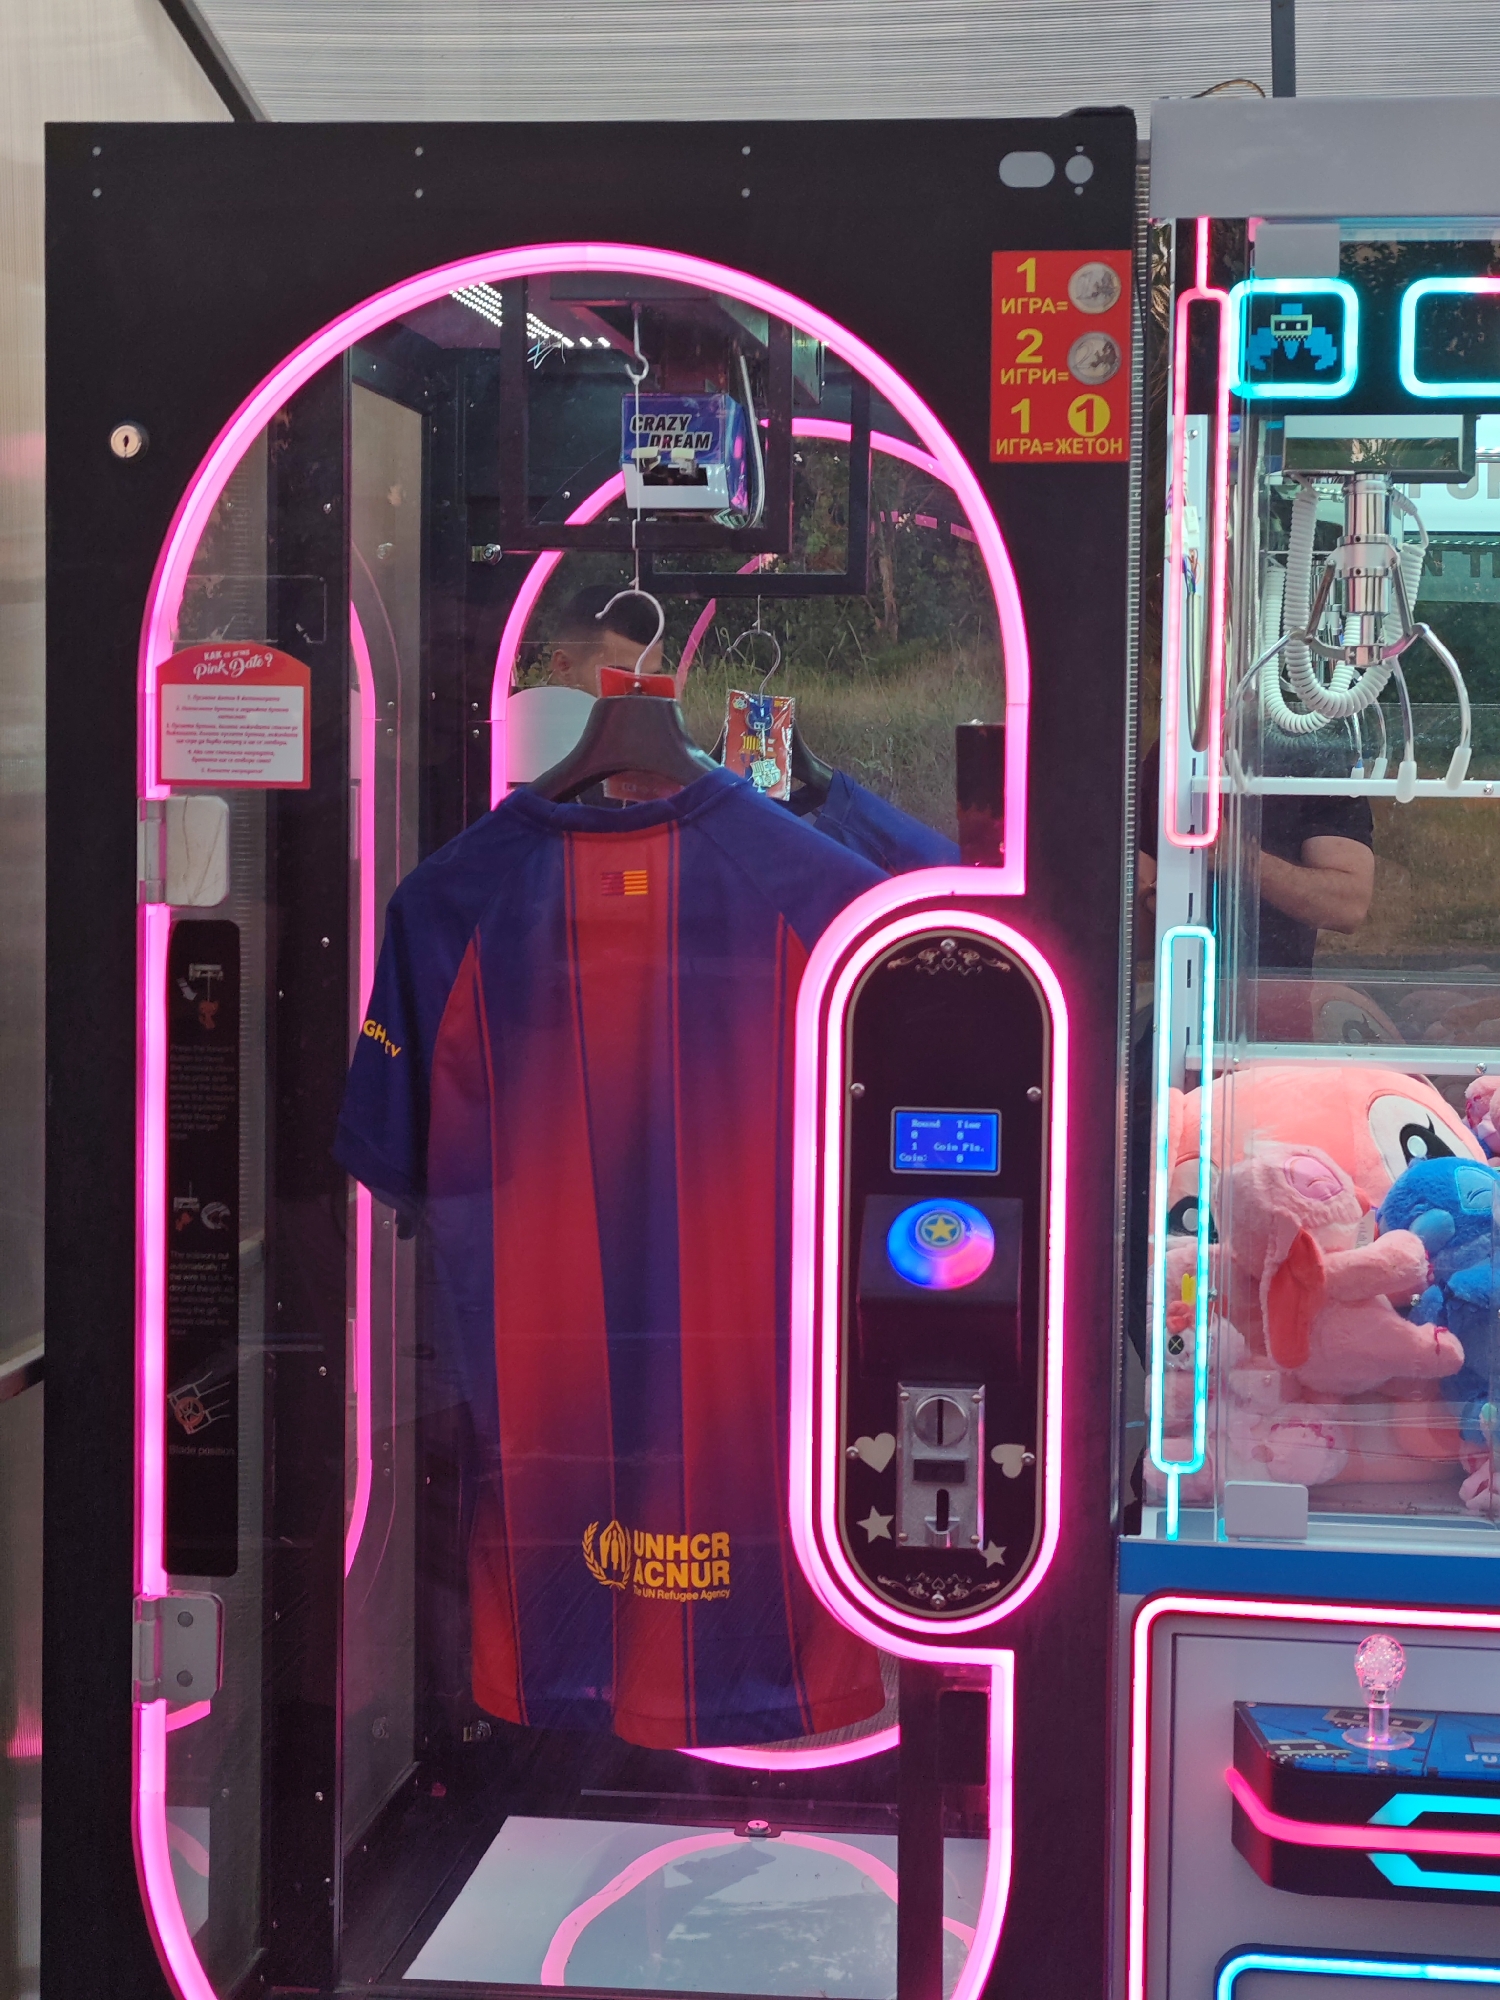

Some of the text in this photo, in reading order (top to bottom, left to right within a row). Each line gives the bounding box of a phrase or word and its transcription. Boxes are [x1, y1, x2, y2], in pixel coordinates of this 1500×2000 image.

[1017, 257, 1036, 293] 1
[1001, 298, 1068, 314] ИГРА=
[1015, 328, 1043, 364] 2
[1001, 368, 1069, 384] ИГРИ=
[630, 414, 691, 432] CRAZY
[1011, 398, 1030, 434] 1
[649, 433, 711, 449] DREAM
[193, 660, 229, 680] Pink
[911, 1118, 941, 1128] Round
[633, 1530, 730, 1560] UNHCR
[633, 1559, 730, 1588] ACNUR
[643, 1588, 655, 1598] UN
[657, 1589, 698, 1602] Refugee
[700, 1589, 730, 1601] Agency
